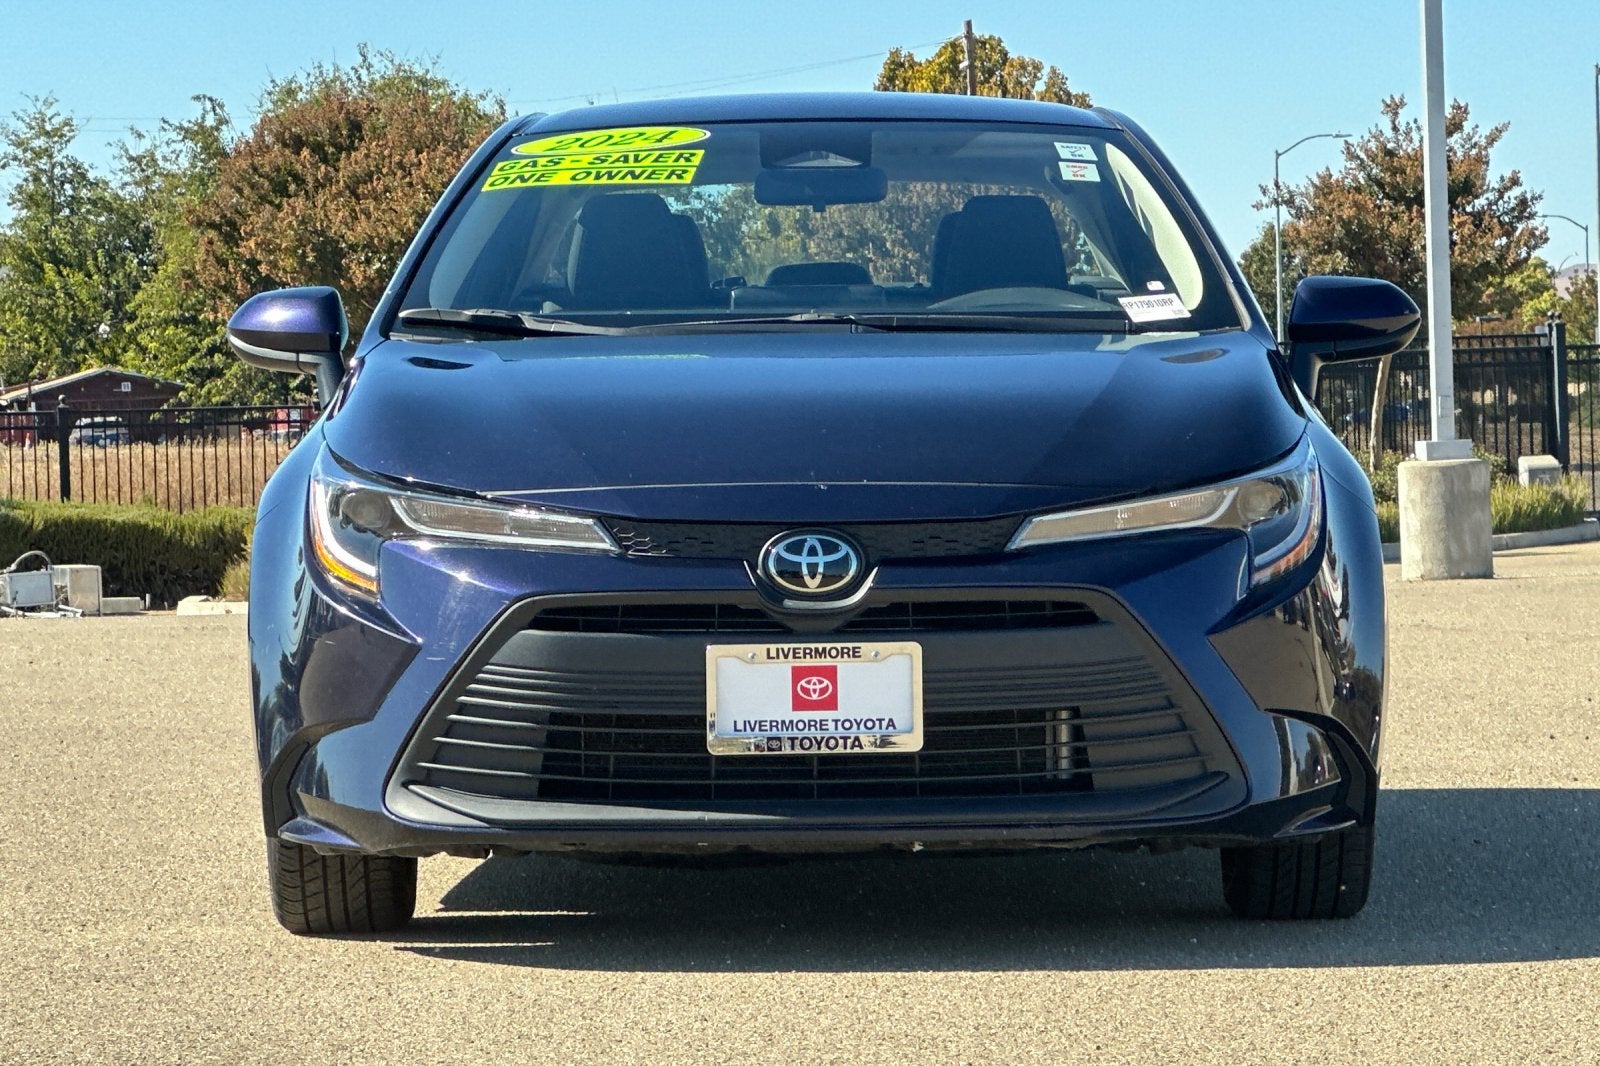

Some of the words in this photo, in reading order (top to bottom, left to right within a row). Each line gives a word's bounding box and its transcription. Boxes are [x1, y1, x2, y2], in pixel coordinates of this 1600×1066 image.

[544, 130, 678, 152] 2024
[488, 171, 558, 187] ONE
[570, 169, 690, 181] OWNER
[766, 646, 862, 660] LIVERMORE
[733, 719, 829, 732] LIVERMORE
[830, 718, 897, 731] TOYOTA
[787, 736, 864, 751] TOYOTA
